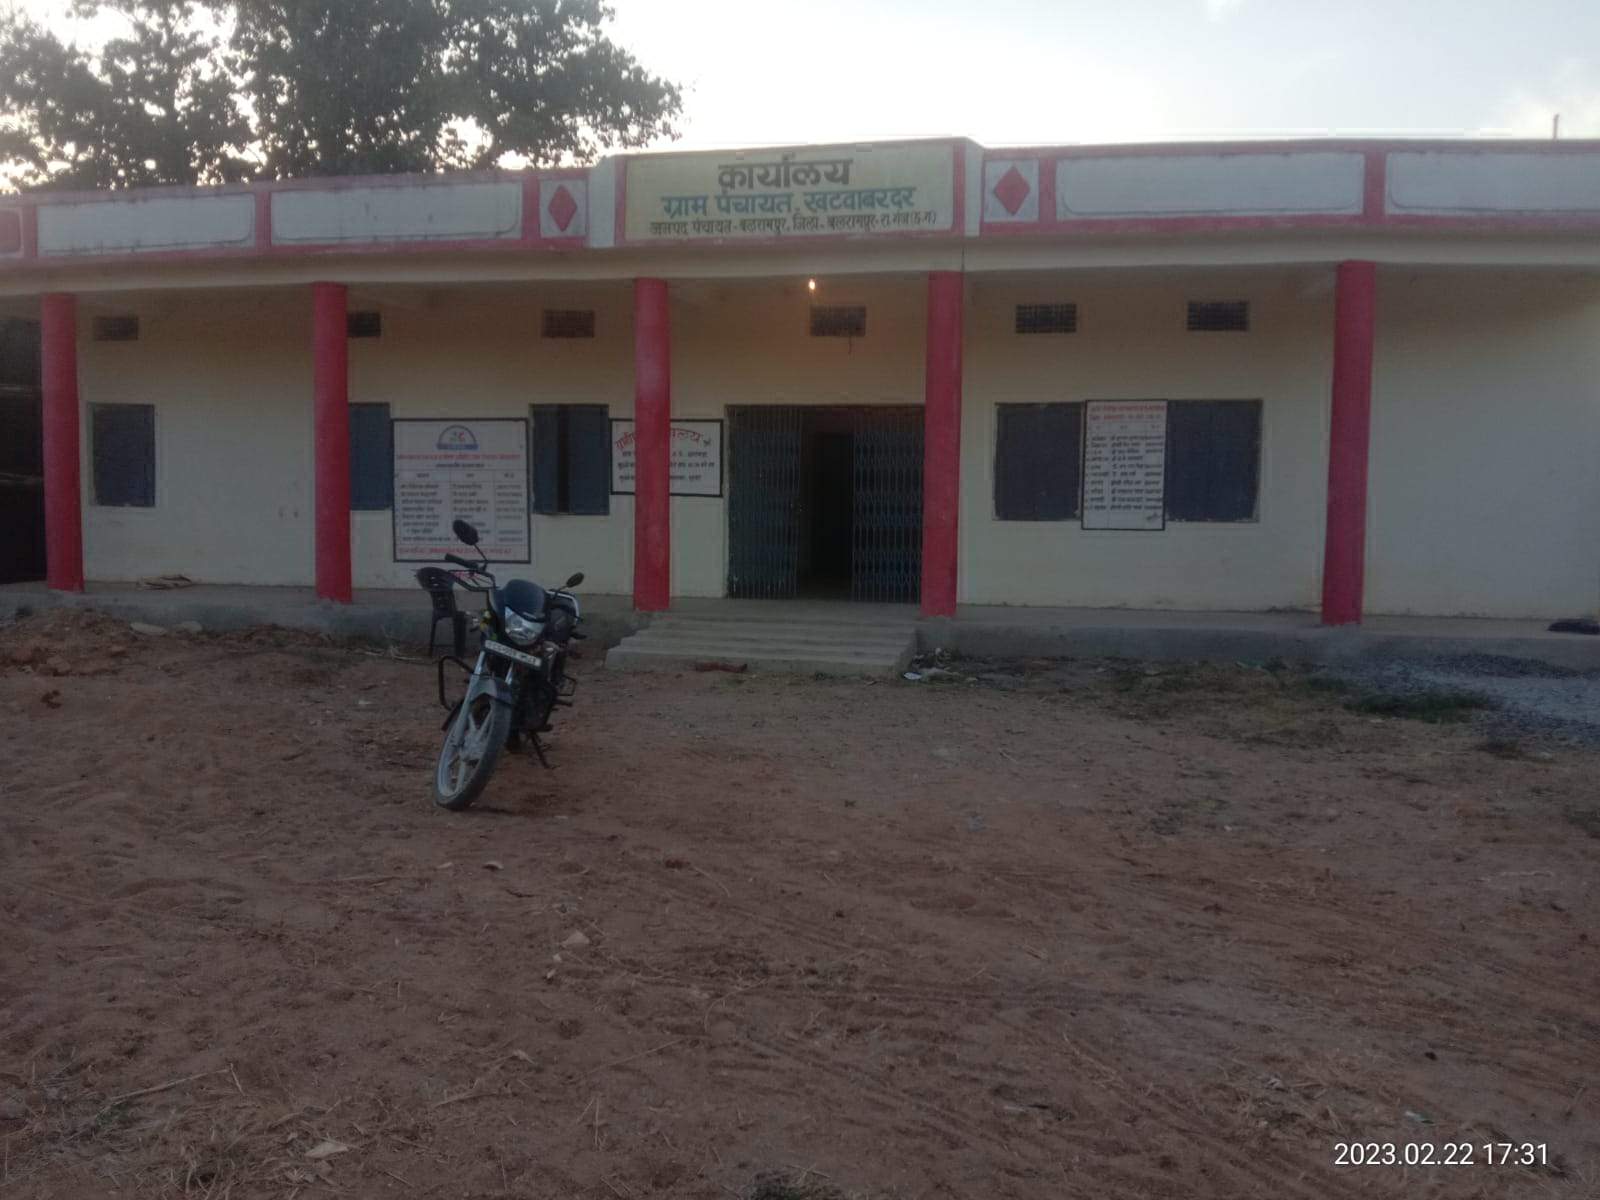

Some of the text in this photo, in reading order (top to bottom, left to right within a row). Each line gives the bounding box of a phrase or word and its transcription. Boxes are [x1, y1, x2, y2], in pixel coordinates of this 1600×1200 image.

[718, 153, 853, 190] कार्यालय
[660, 194, 708, 219] ग्राम
[714, 190, 794, 214] पंचायत
